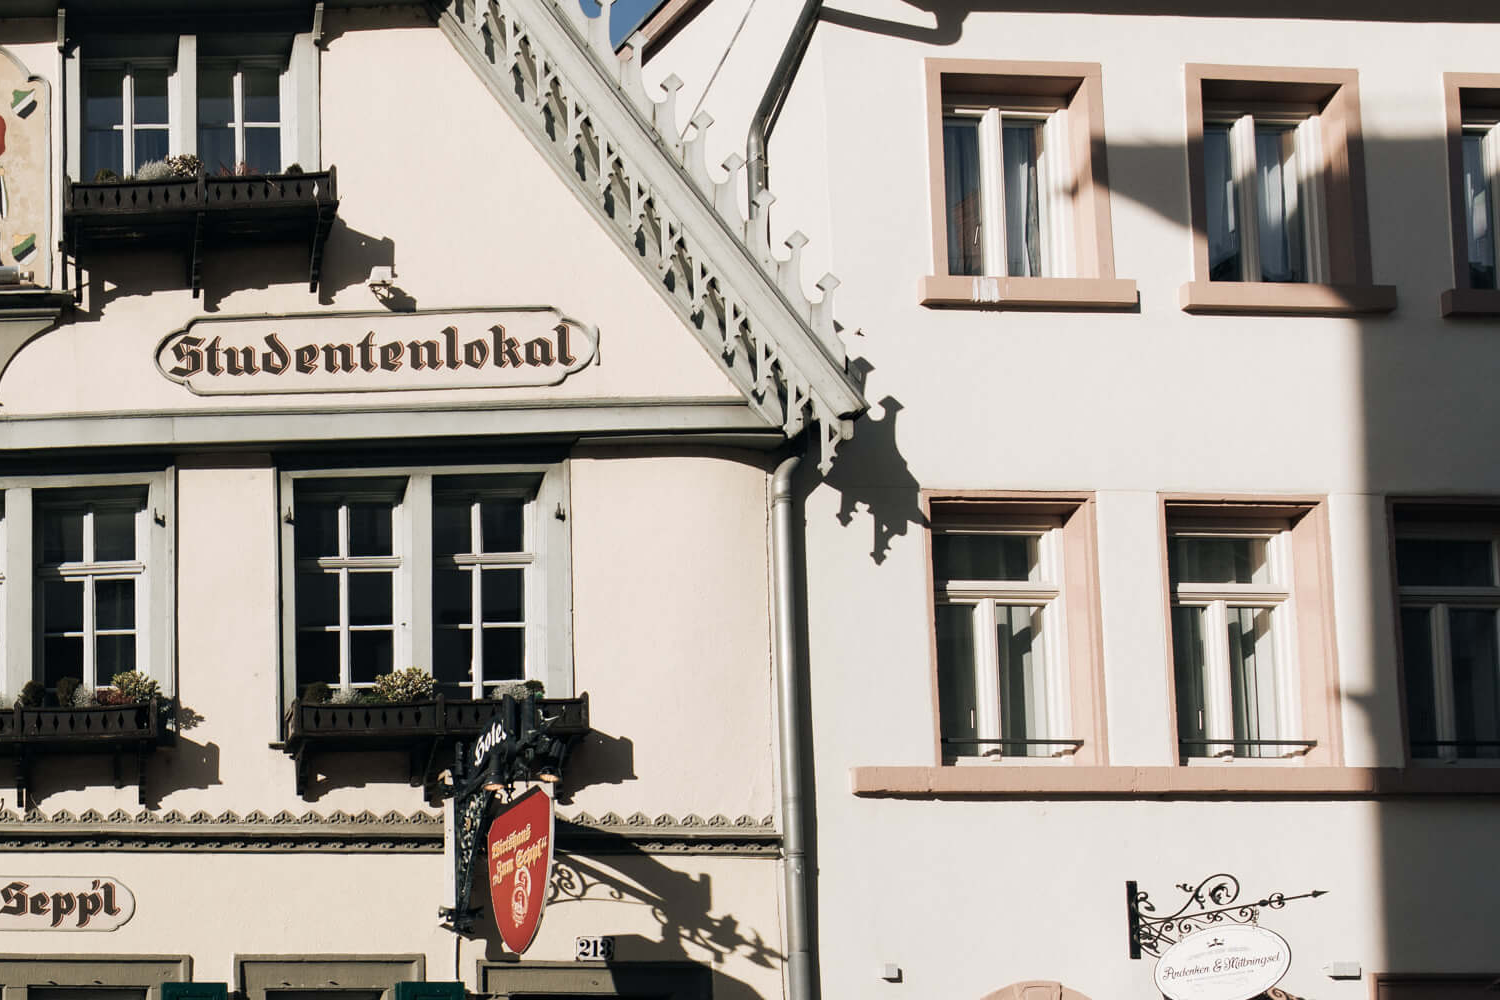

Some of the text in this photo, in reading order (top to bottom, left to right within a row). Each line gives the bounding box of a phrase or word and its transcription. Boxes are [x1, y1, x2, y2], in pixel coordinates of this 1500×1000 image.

[168, 324, 577, 377] Studentenlokal
[1162, 964, 1210, 980] Andenken
[1212, 959, 1223, 973] &
